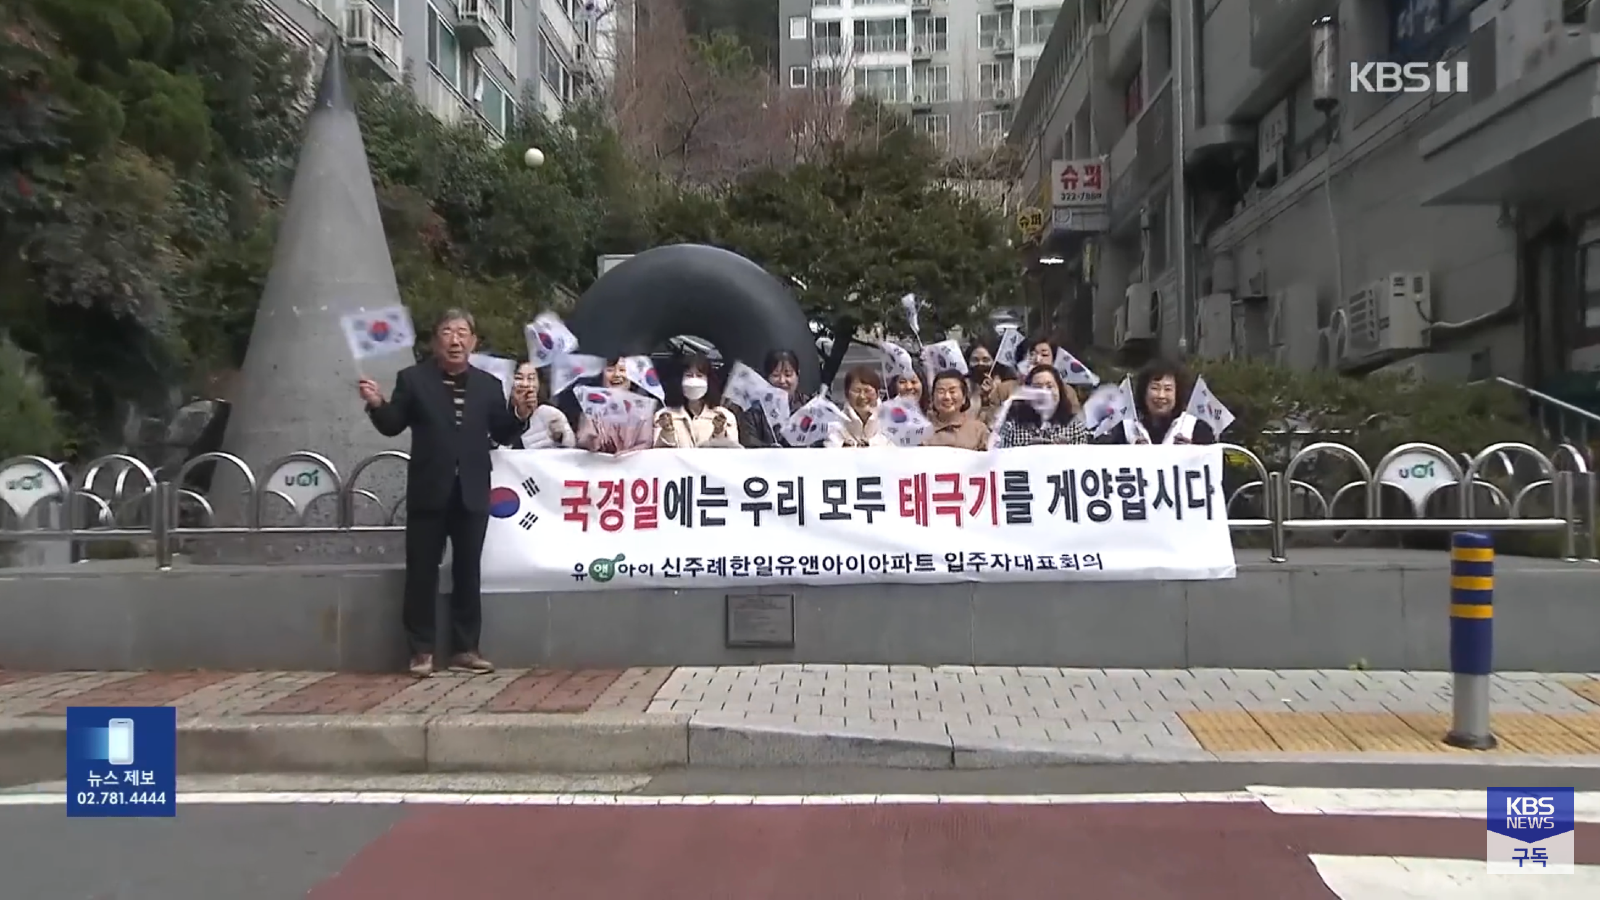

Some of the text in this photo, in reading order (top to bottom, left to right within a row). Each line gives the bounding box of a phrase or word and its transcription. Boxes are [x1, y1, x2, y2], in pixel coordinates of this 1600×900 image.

[1060, 164, 1102, 190] 슈퍼
[1018, 213, 1042, 229] 슈퍼
[560, 464, 1215, 533] 국경일에는 우리 모두 태극기를 게양합시다
[660, 552, 936, 579] 신주례한일유앤아이아파트
[943, 550, 1104, 574] 입주자대표회의
